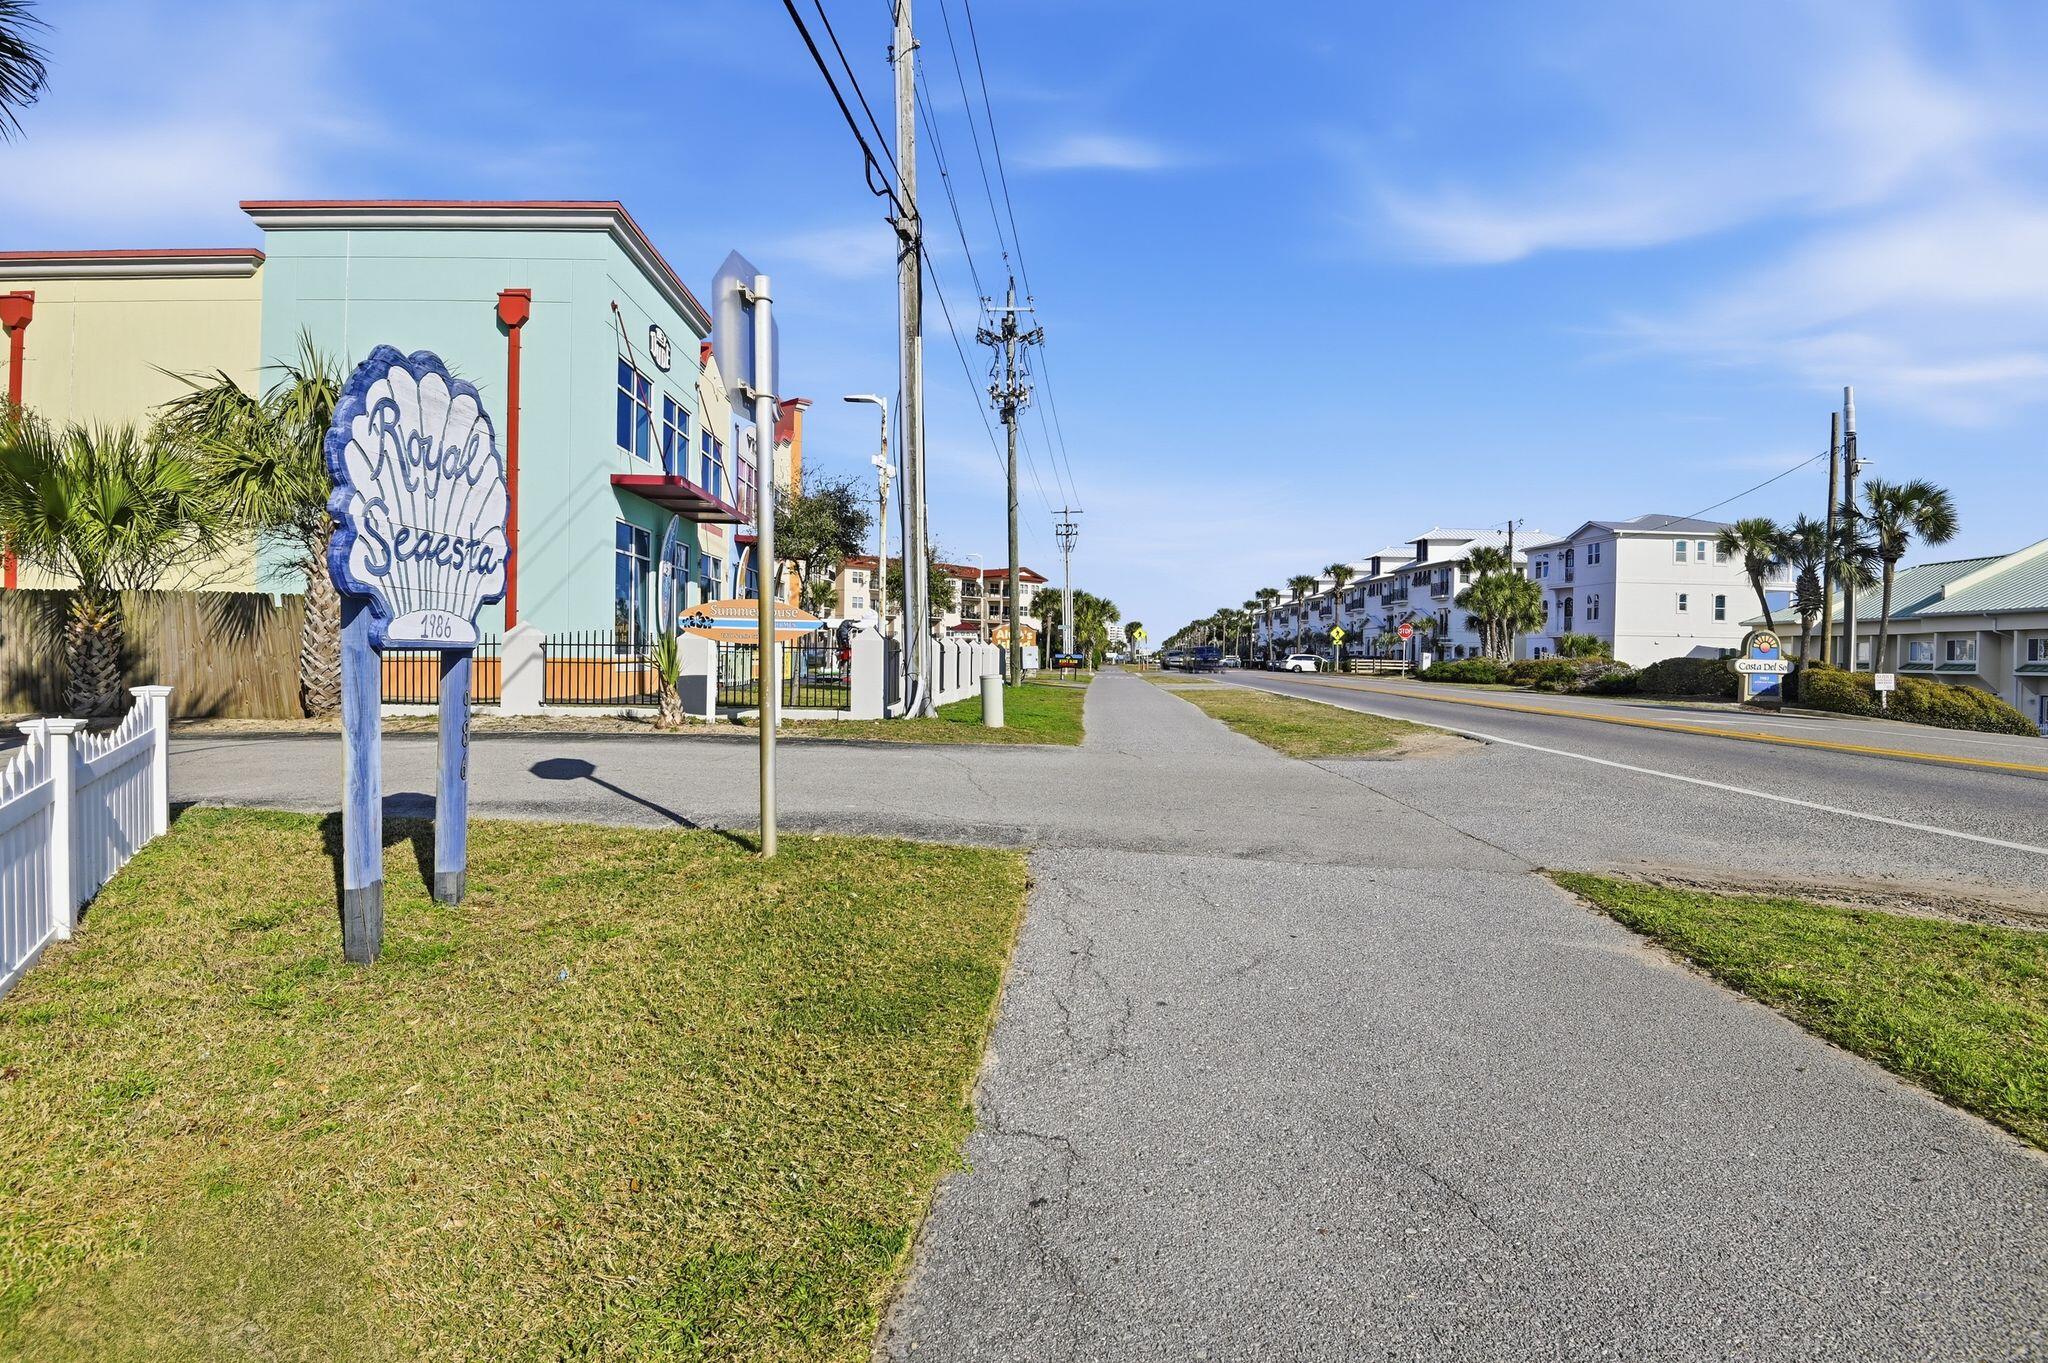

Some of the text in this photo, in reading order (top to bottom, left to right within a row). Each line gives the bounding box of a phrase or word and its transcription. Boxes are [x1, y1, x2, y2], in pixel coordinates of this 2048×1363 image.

[650, 330, 671, 369] DUDE
[368, 397, 484, 498] Royal
[362, 496, 500, 577] Seaesta
[710, 604, 799, 618] Summeouse
[421, 614, 452, 638] 1986
[996, 629, 1033, 640] Al's
[1739, 662, 1761, 671] Costa
[1763, 662, 1777, 671] Del
